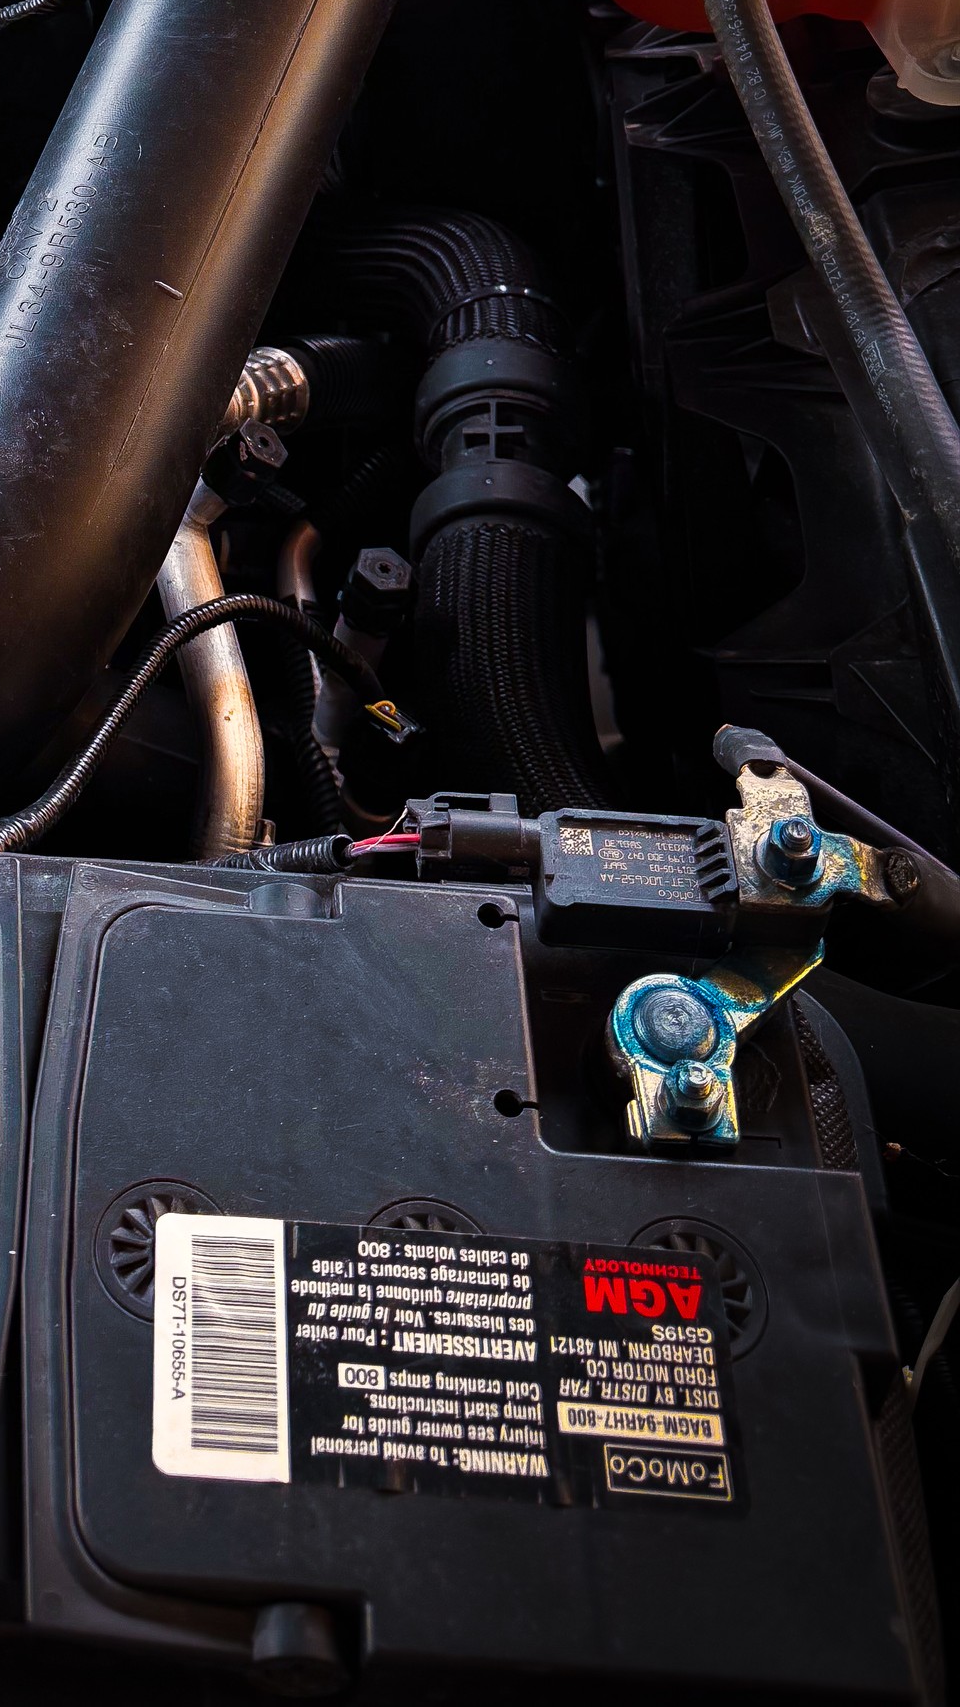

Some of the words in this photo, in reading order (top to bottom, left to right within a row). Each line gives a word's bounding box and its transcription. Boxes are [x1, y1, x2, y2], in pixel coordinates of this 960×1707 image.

[658, 889, 700, 901] FoMoCo
[357, 1239, 390, 1257] 800
[403, 1243, 455, 1261] volants
[459, 1248, 506, 1266] cables
[311, 1258, 353, 1277] l'aide
[510, 1251, 527, 1269] de
[582, 1257, 701, 1279] TECHNOLOGY
[369, 1262, 425, 1282] secours
[429, 1264, 507, 1289] demarrage
[512, 1273, 529, 1291] de
[290, 1278, 352, 1298] methode
[357, 1283, 371, 1300] la
[375, 1284, 441, 1304] quidonne
[582, 1274, 702, 1320] AGM
[306, 1301, 325, 1318] du
[445, 1289, 531, 1310] proprietaire
[329, 1301, 370, 1321] guide
[374, 1306, 388, 1323] le
[393, 1308, 423, 1328] Voir
[428, 1310, 503, 1333] blessures.
[508, 1317, 533, 1335] des
[171, 1276, 187, 1401] DS7T-10655-A
[295, 1323, 336, 1341] eviter
[341, 1326, 376, 1346] Pour
[650, 1323, 712, 1342] G519S
[391, 1330, 536, 1362] AVERTISSEMENT
[549, 1335, 593, 1355] 48121
[597, 1338, 617, 1357] MI
[621, 1338, 714, 1365] DEARBORN,
[343, 1366, 379, 1386] 800
[579, 1357, 607, 1377] CO.
[611, 1360, 668, 1382] MOTOR
[673, 1365, 716, 1386] FORD
[388, 1369, 430, 1389] amps
[434, 1371, 501, 1396] cranking
[559, 1377, 590, 1398] PAR
[505, 1380, 541, 1401] Cold
[595, 1380, 647, 1402] DISTR.
[653, 1385, 674, 1405] BY
[678, 1386, 718, 1407] DIST.
[363, 1392, 458, 1418] instructions.
[463, 1400, 498, 1421] start
[502, 1397, 543, 1425] jump
[340, 1414, 364, 1434] for
[367, 1415, 410, 1436] guide
[414, 1420, 462, 1438] owner
[467, 1425, 494, 1441] see
[567, 1408, 711, 1438] BAGM-94RH7-800
[309, 1434, 378, 1456] personal
[499, 1422, 546, 1449] injury
[382, 1440, 424, 1460] avoid
[428, 1445, 447, 1466] To
[452, 1446, 549, 1477] WARNING:
[609, 1455, 724, 1488] FoMoCo
